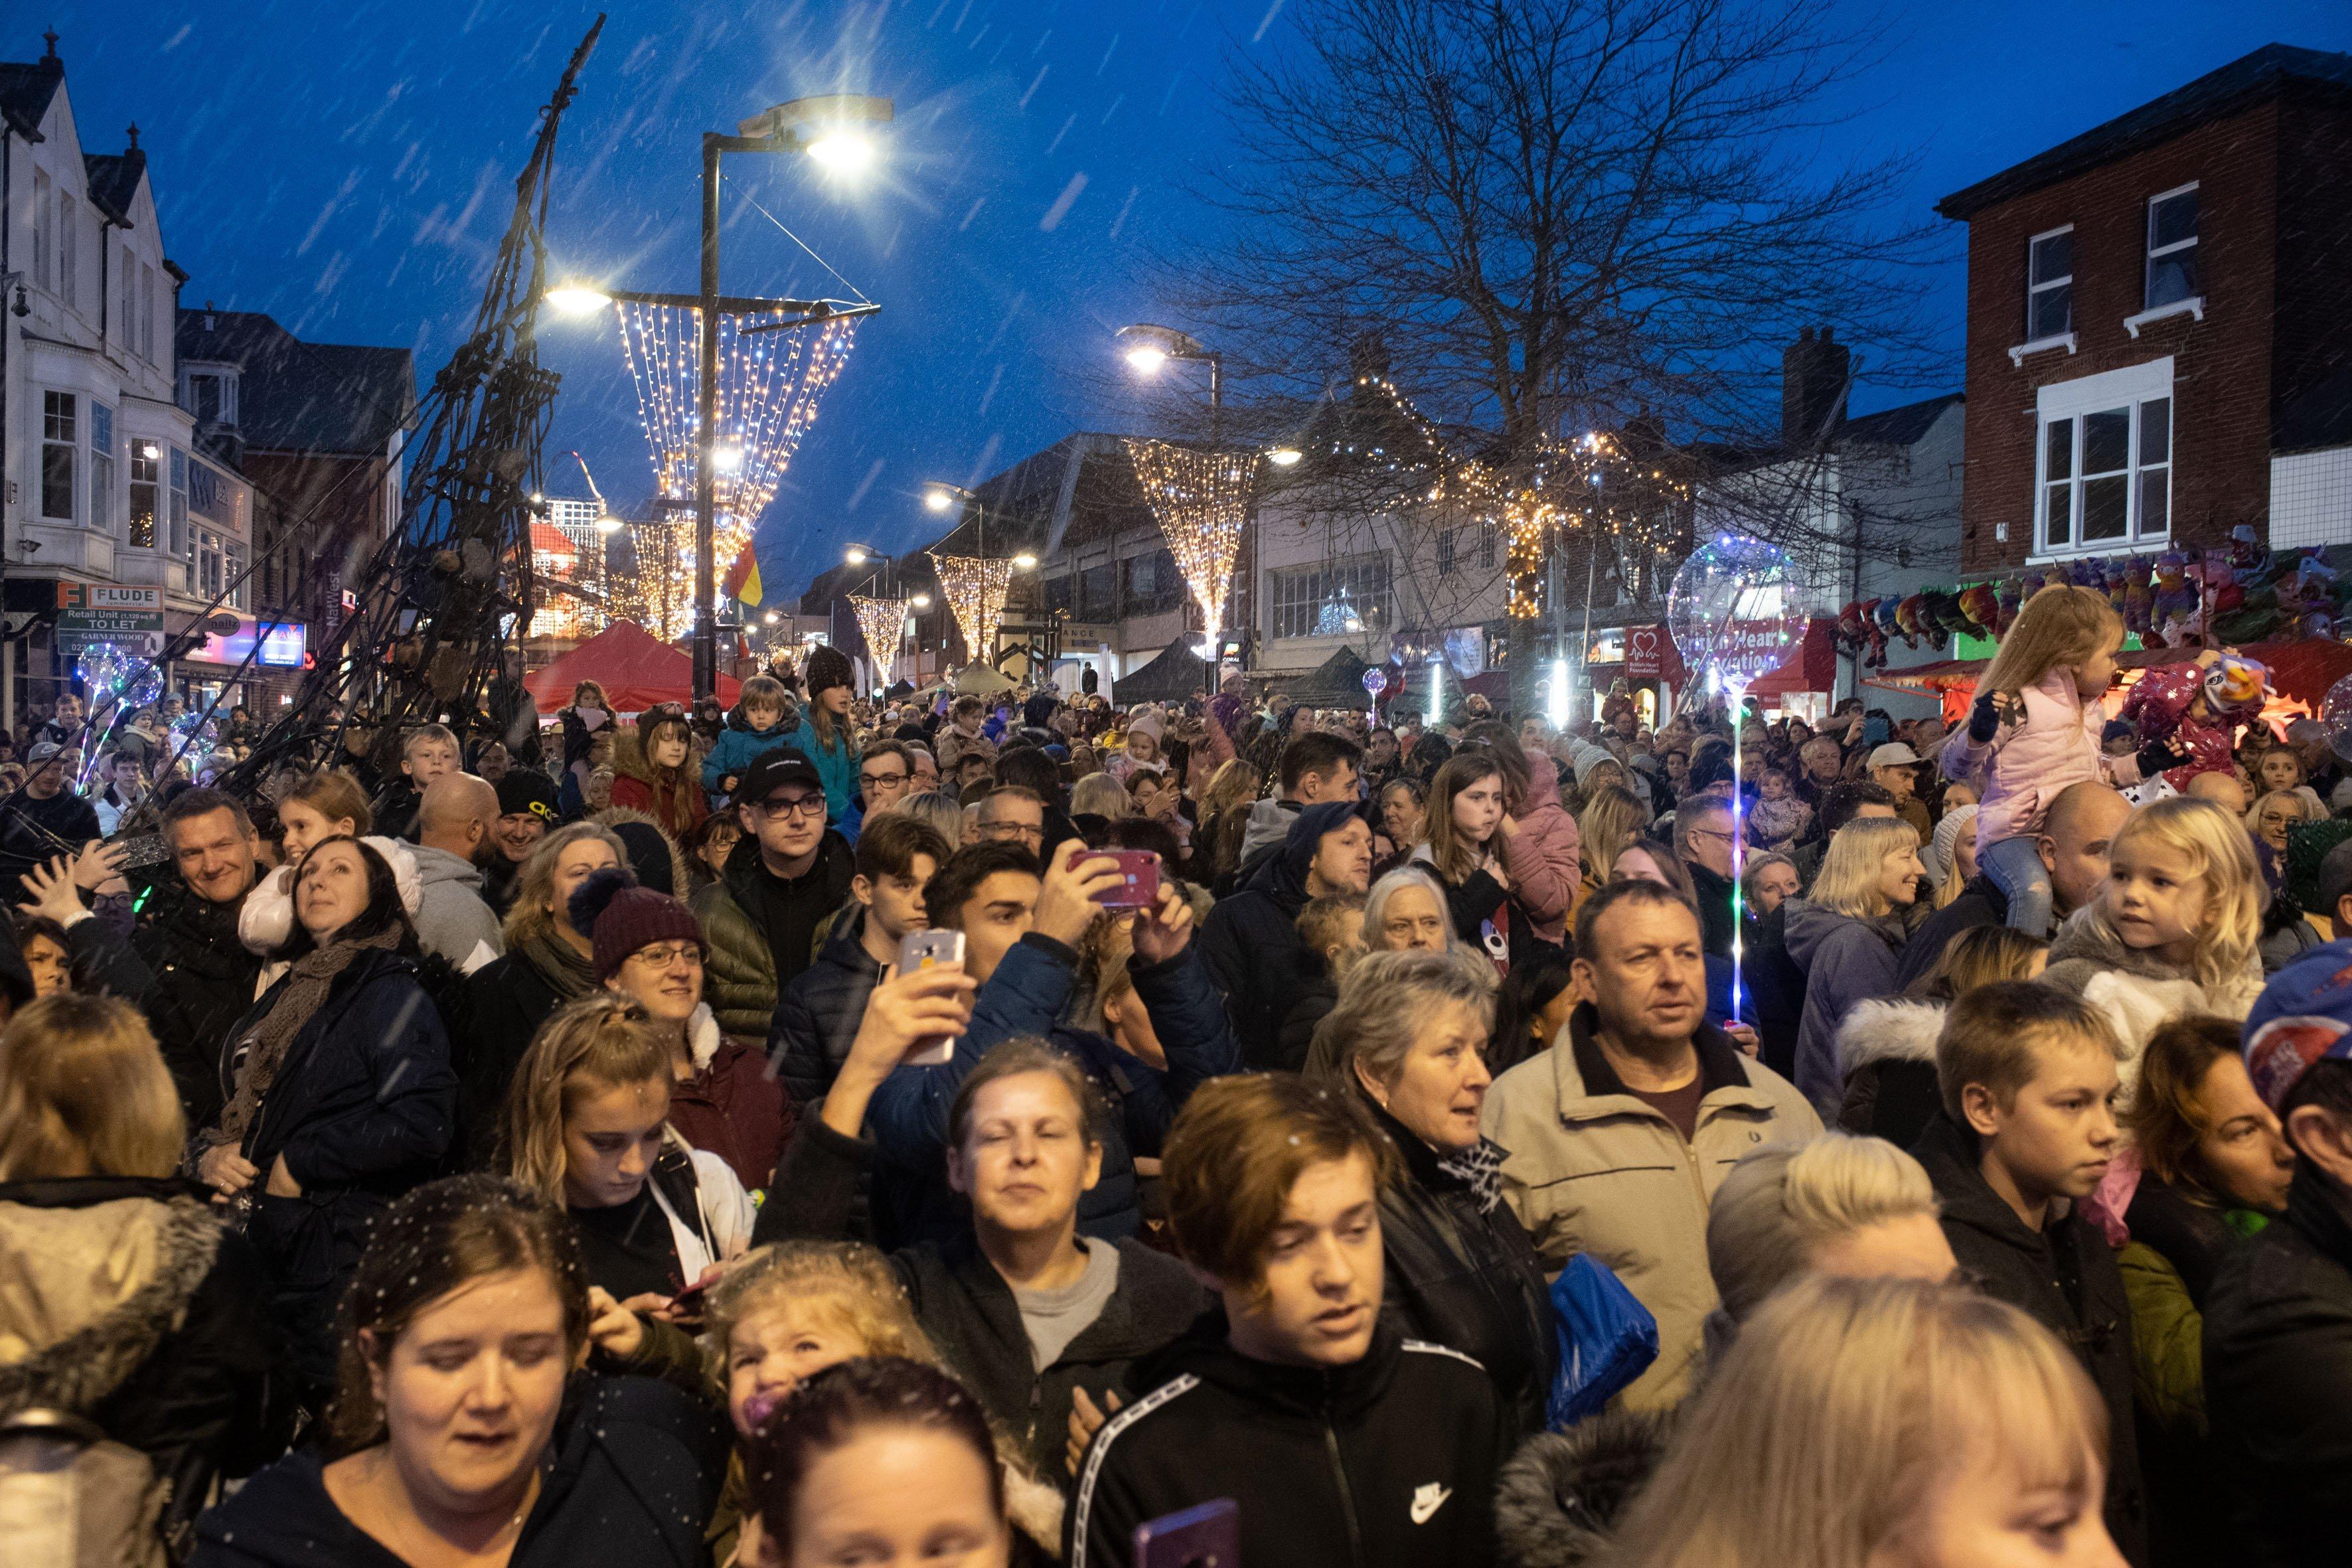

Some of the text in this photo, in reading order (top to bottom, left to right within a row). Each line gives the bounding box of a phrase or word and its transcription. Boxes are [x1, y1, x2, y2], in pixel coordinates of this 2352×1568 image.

[98, 589, 153, 601] FLUDE
[326, 572, 340, 626] NatWest
[88, 620, 137, 629] TO LET
[211, 618, 239, 628] nailz
[1684, 652, 1778, 673] Fodation
